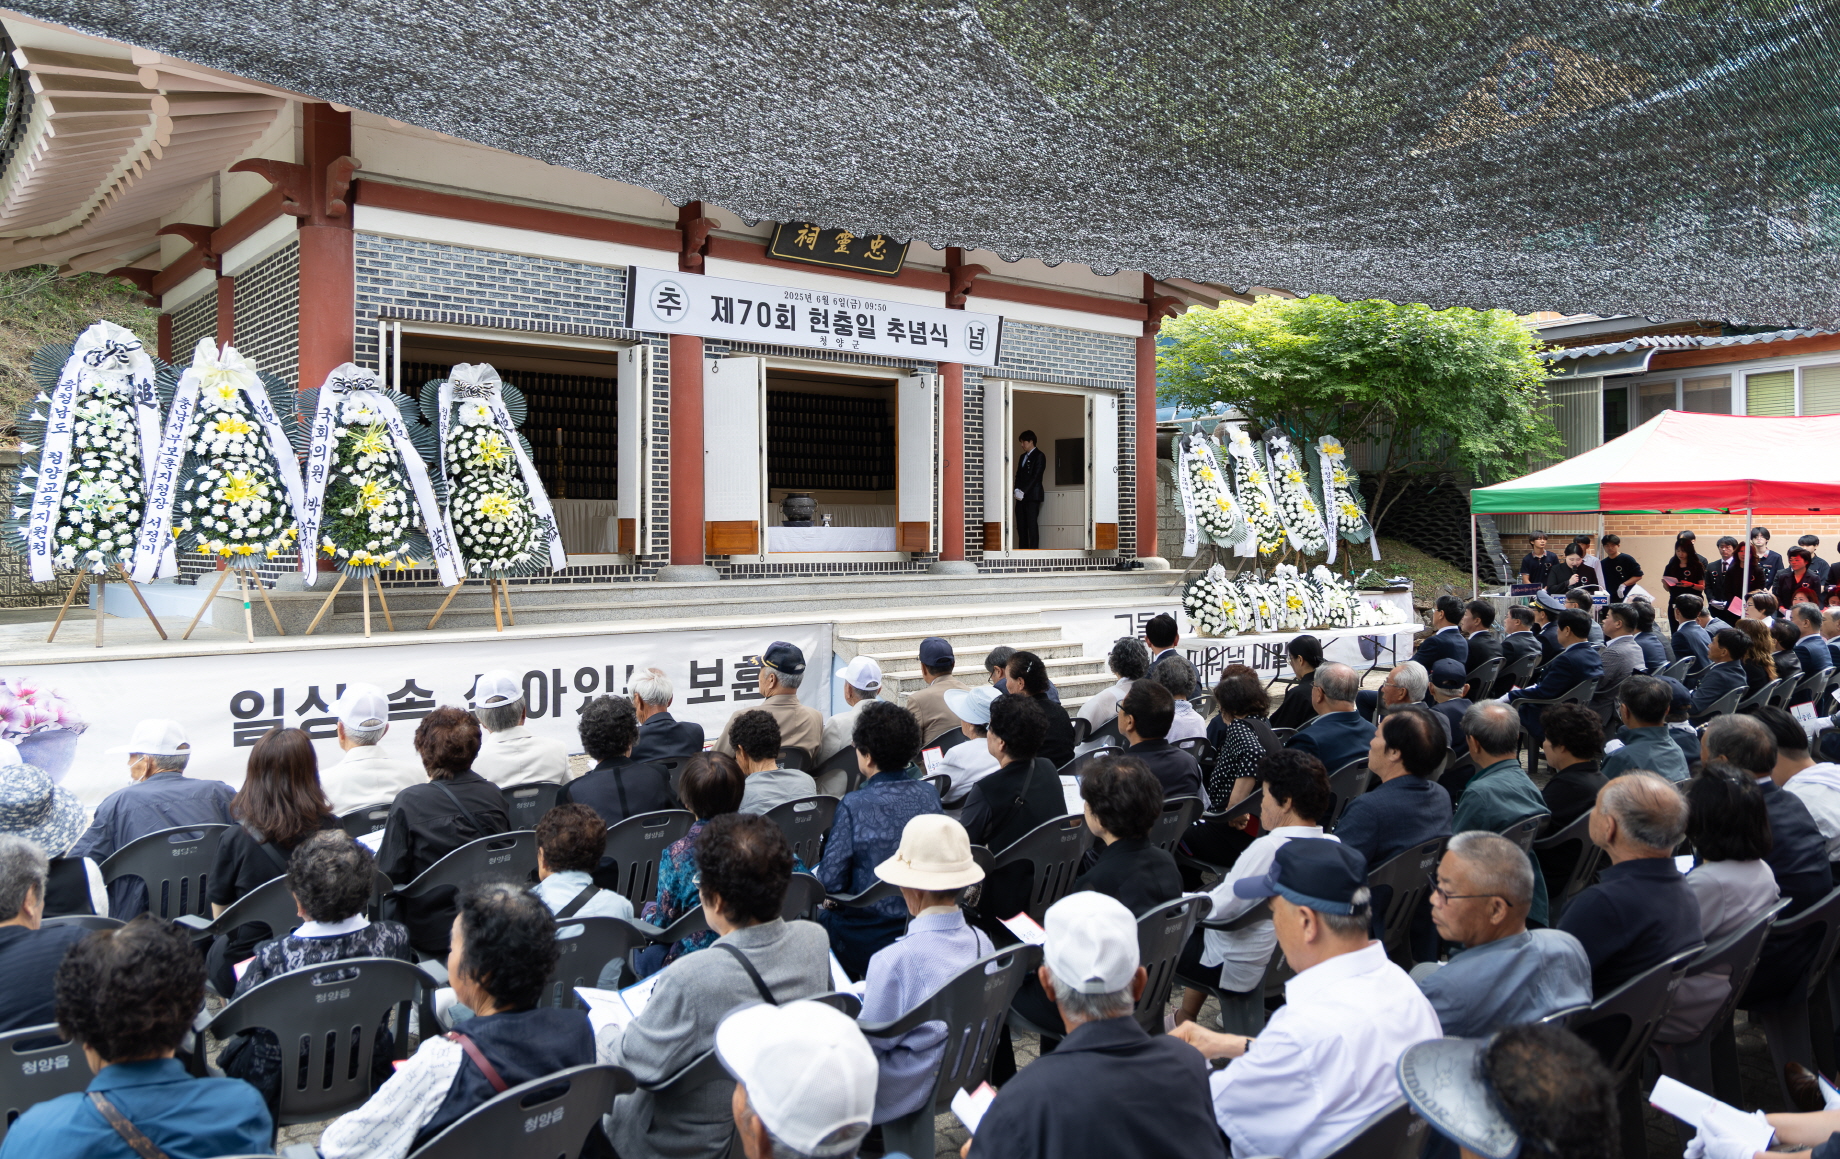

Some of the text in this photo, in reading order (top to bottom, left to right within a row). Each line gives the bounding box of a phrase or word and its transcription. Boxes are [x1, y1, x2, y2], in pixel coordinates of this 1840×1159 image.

[657, 287, 682, 316] 추
[784, 291, 887, 311] 2025년 6월 6일(금) 09:50
[711, 295, 948, 348] 제70회 현충일 추념식
[969, 327, 985, 350] 념
[311, 407, 333, 483] 국회의원
[32, 379, 76, 556] 충청남도 청양교육지원청
[141, 517, 162, 555] 서정미
[229, 683, 347, 747] 일상
[315, 988, 351, 1003] 청양읍
[21, 1054, 70, 1074] 청양읍
[523, 1106, 564, 1132] 청양읍
